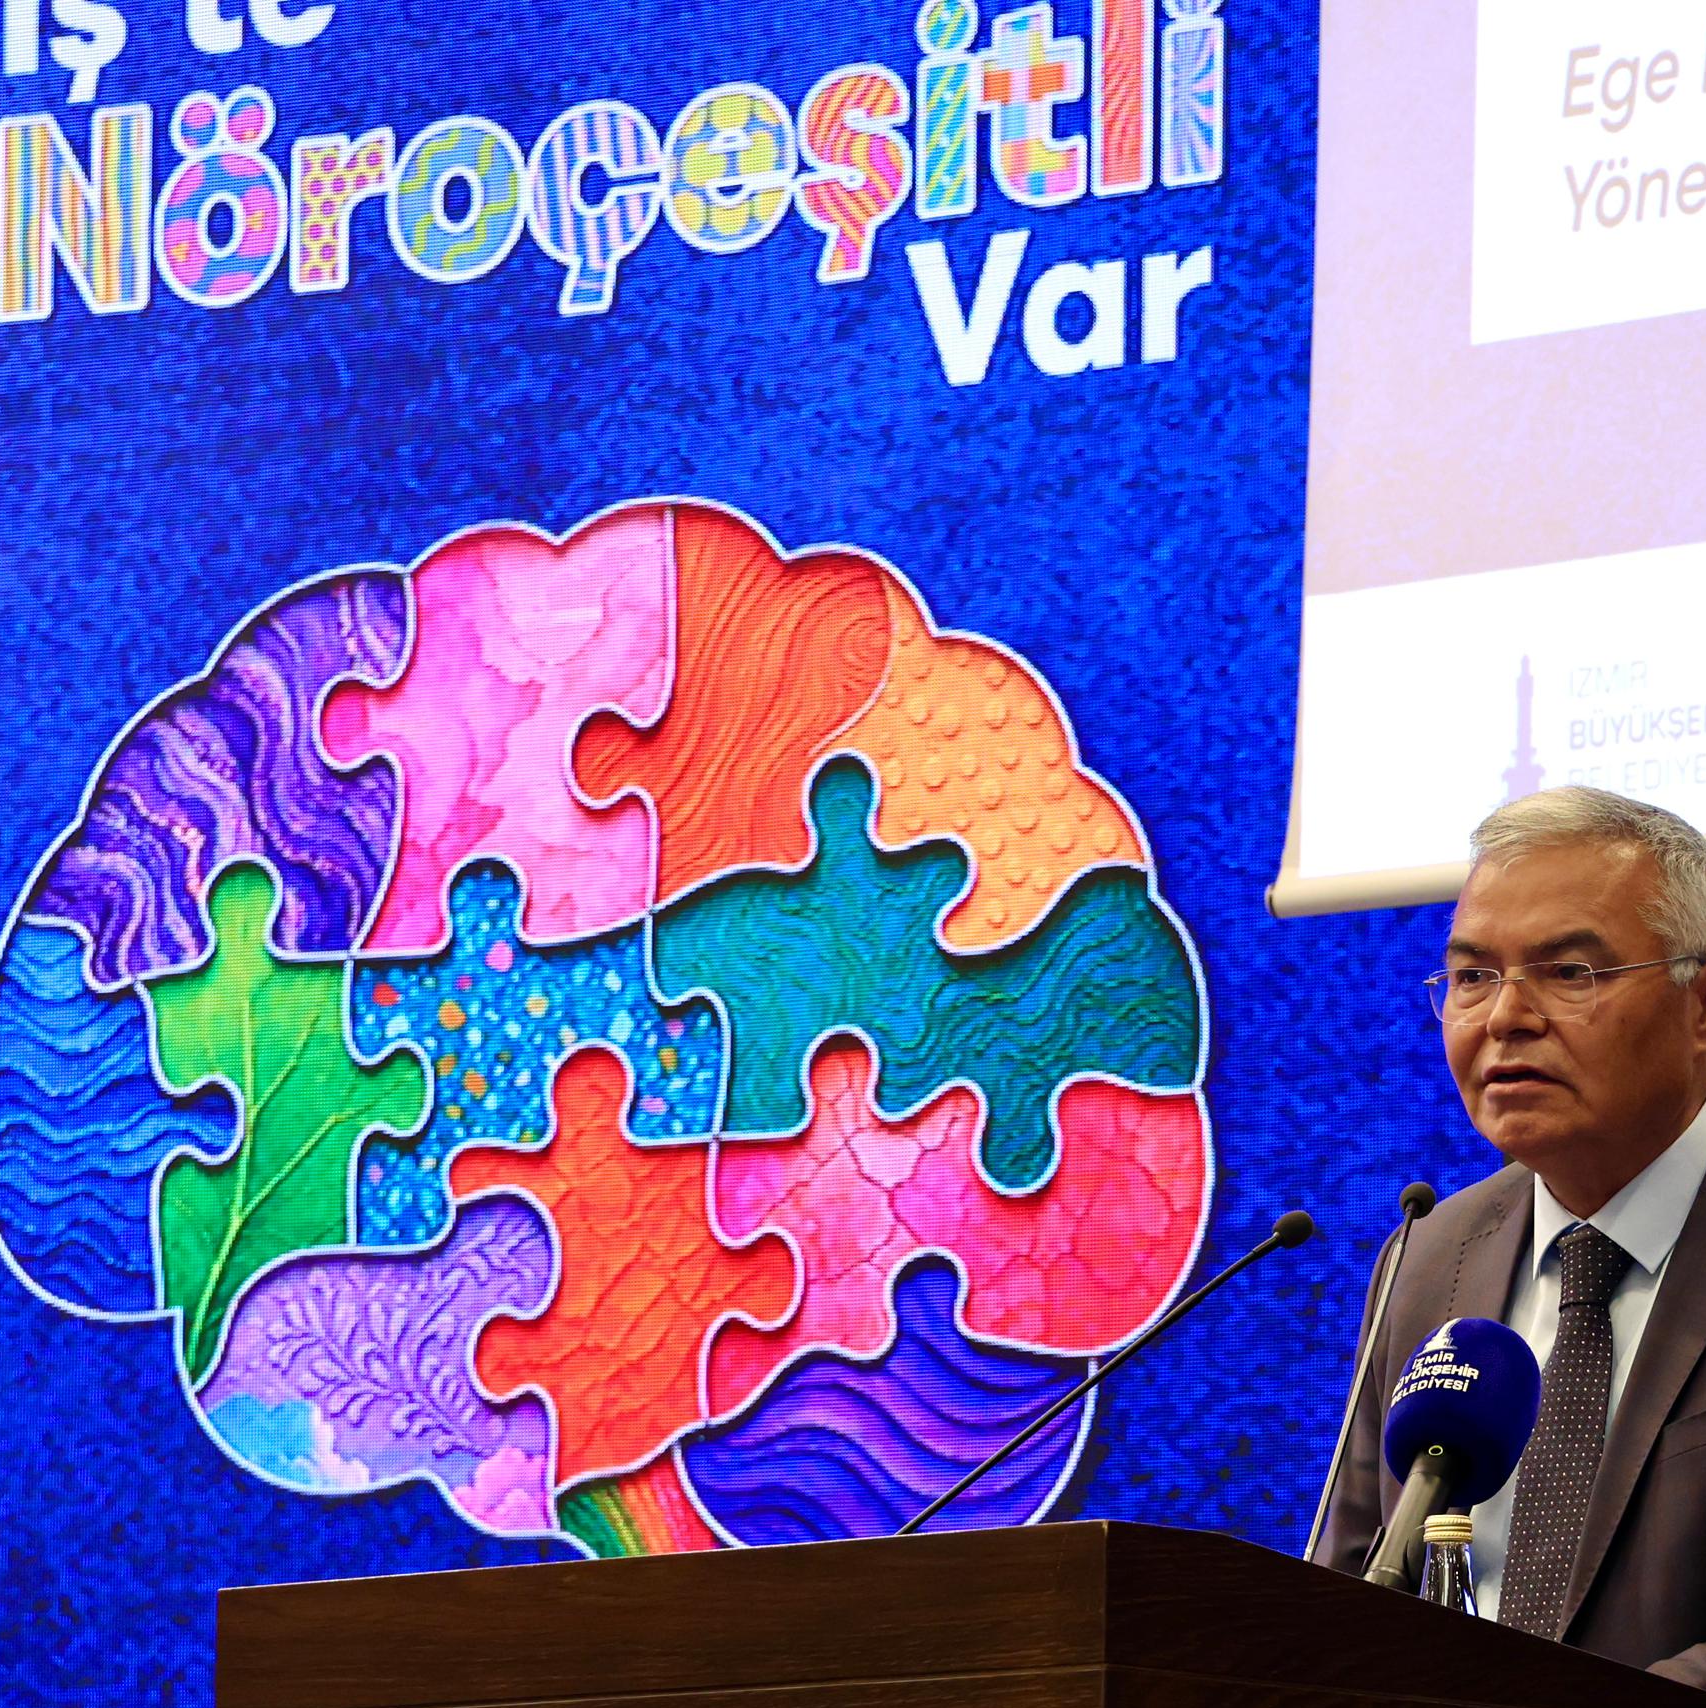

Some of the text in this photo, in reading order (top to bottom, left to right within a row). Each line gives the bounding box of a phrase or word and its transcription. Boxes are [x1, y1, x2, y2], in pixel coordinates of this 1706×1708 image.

[1563, 45, 1679, 133] Ege
[905, 229, 1212, 386] Var
[1411, 1350, 1454, 1370] İZMİR
